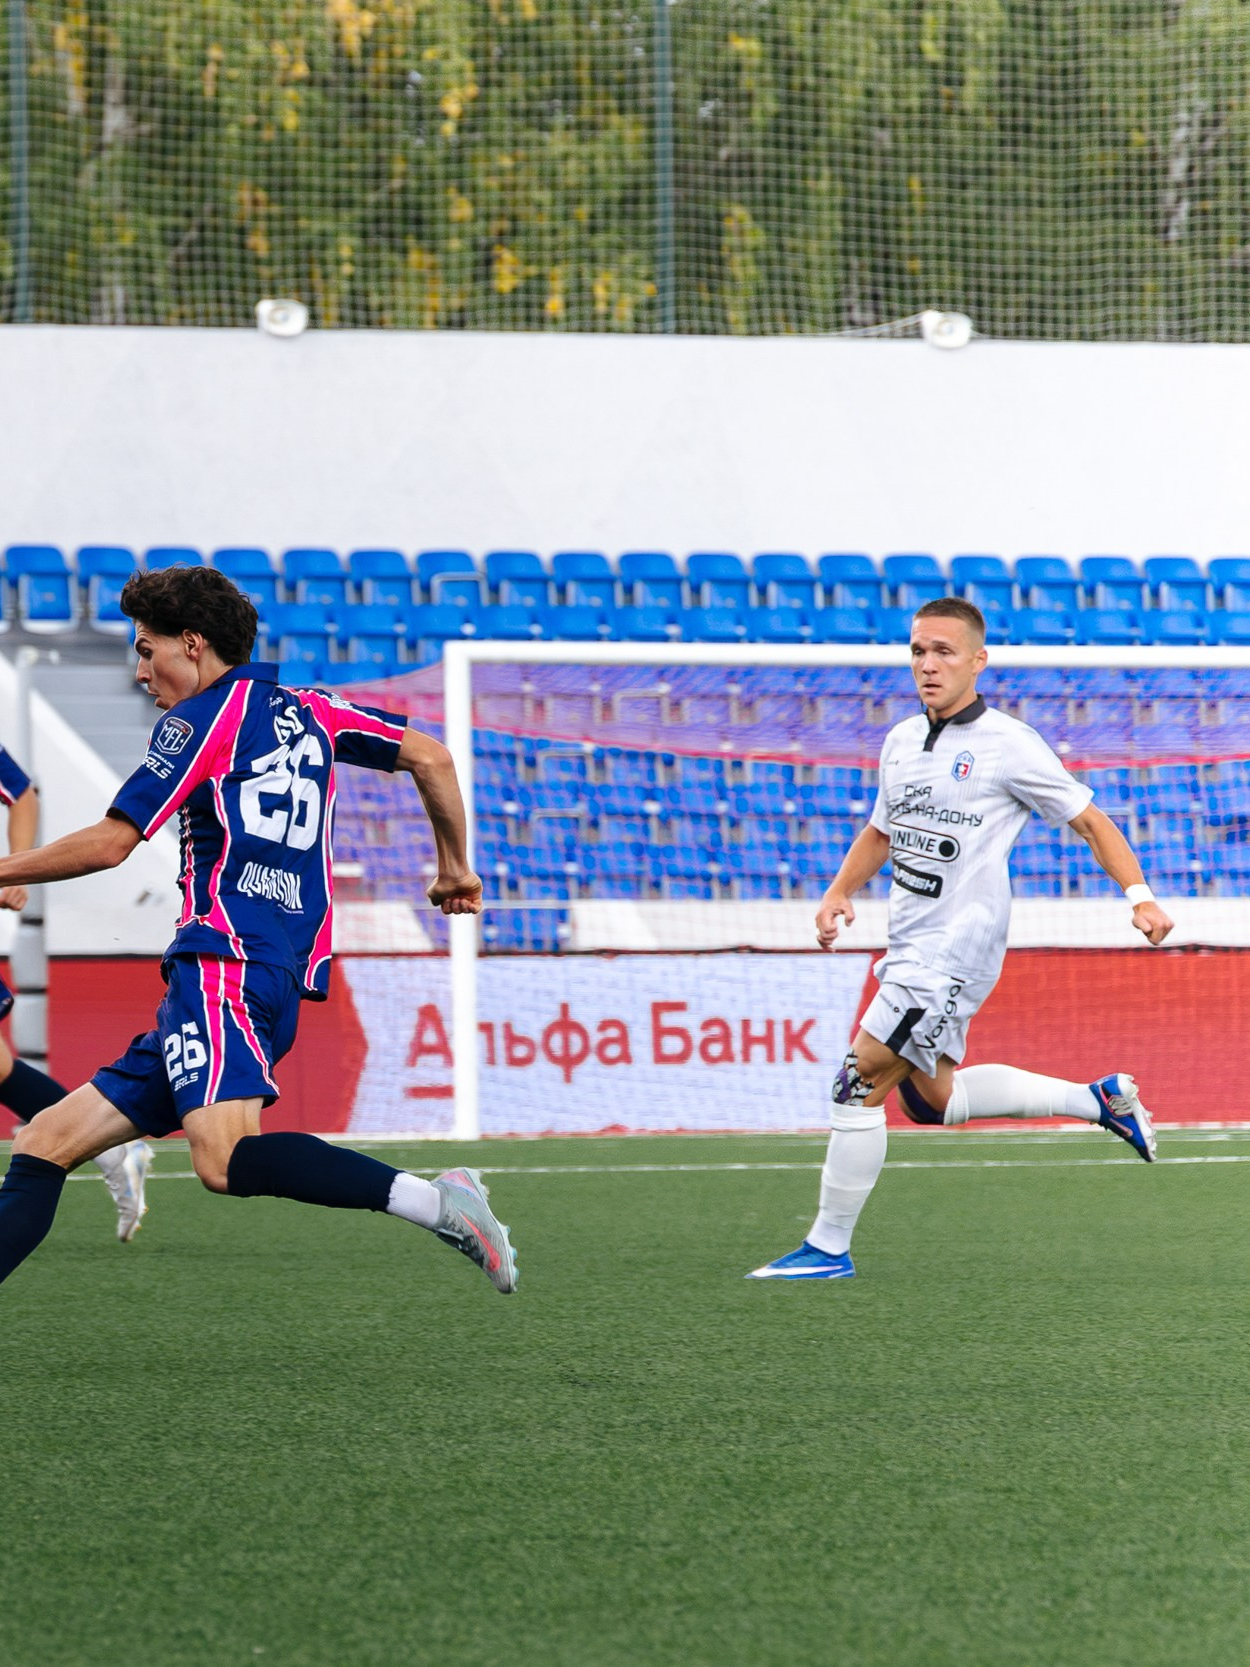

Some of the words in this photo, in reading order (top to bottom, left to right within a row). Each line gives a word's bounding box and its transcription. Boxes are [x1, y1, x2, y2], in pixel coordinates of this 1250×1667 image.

[239, 733, 325, 852] 26
[904, 784, 933, 799] СКА
[892, 830, 936, 853] INLINE
[164, 1021, 208, 1083] 26
[650, 1001, 819, 1065] Банк
